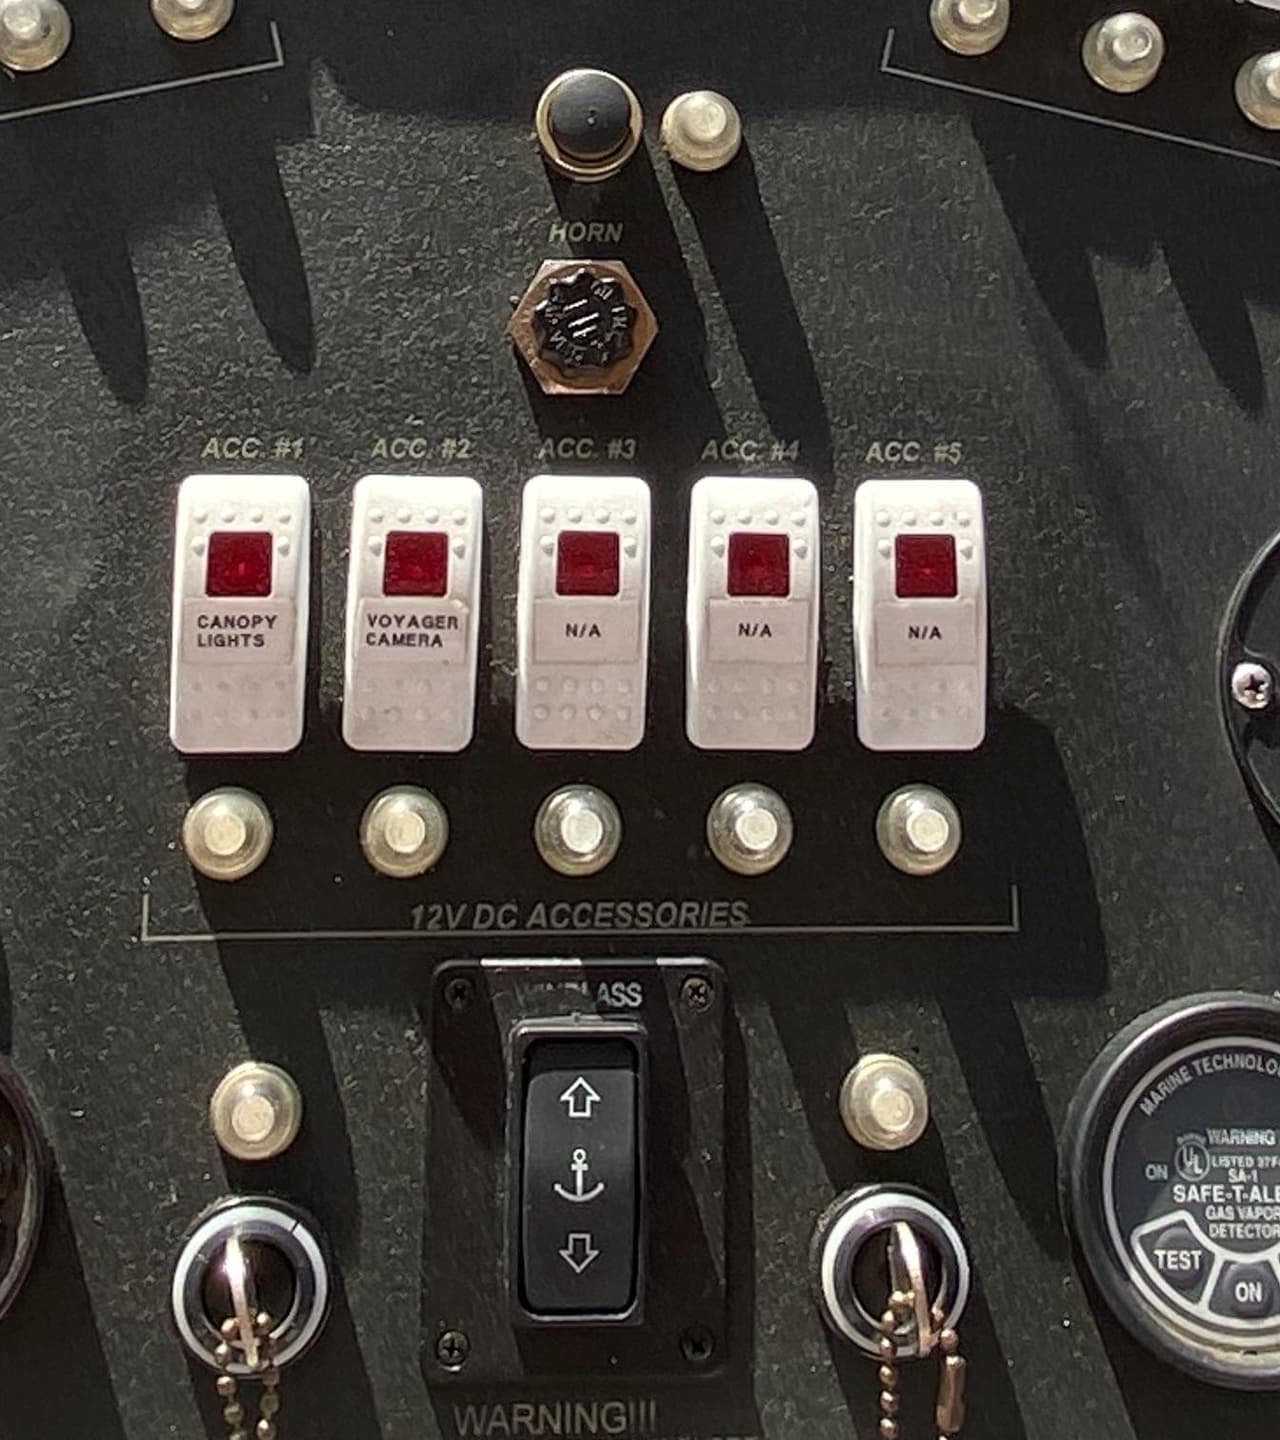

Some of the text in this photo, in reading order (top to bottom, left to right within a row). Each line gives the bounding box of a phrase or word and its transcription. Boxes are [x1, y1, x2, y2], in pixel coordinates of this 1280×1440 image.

[548, 222, 623, 242] HORN
[274, 436, 304, 458] #1
[440, 437, 471, 458] #2
[605, 438, 636, 458] #3
[769, 439, 800, 459] #4
[933, 442, 962, 462] #5
[197, 615, 277, 630] CANOPY
[367, 614, 459, 630] VOYAGER
[566, 622, 601, 638] N/A
[738, 622, 771, 639] N/A
[197, 633, 265, 648] LIGHTS
[366, 632, 443, 648] CAMERA
[908, 624, 942, 641] N/A
[411, 901, 750, 930] 12V DC ACCESSORIES
[1140, 1067, 1191, 1116] MARINE
[1206, 1129, 1276, 1145] WARNING
[1211, 1156, 1254, 1169] LISTED
[1145, 1165, 1168, 1180] ON
[1228, 1169, 1258, 1183] SA-1
[1206, 1206, 1234, 1221] GAS
[1209, 1224, 1280, 1239] DETECTOR
[1154, 1251, 1202, 1269] TEST
[1235, 1283, 1262, 1302] ON
[455, 1401, 656, 1436] WARNING!!!
